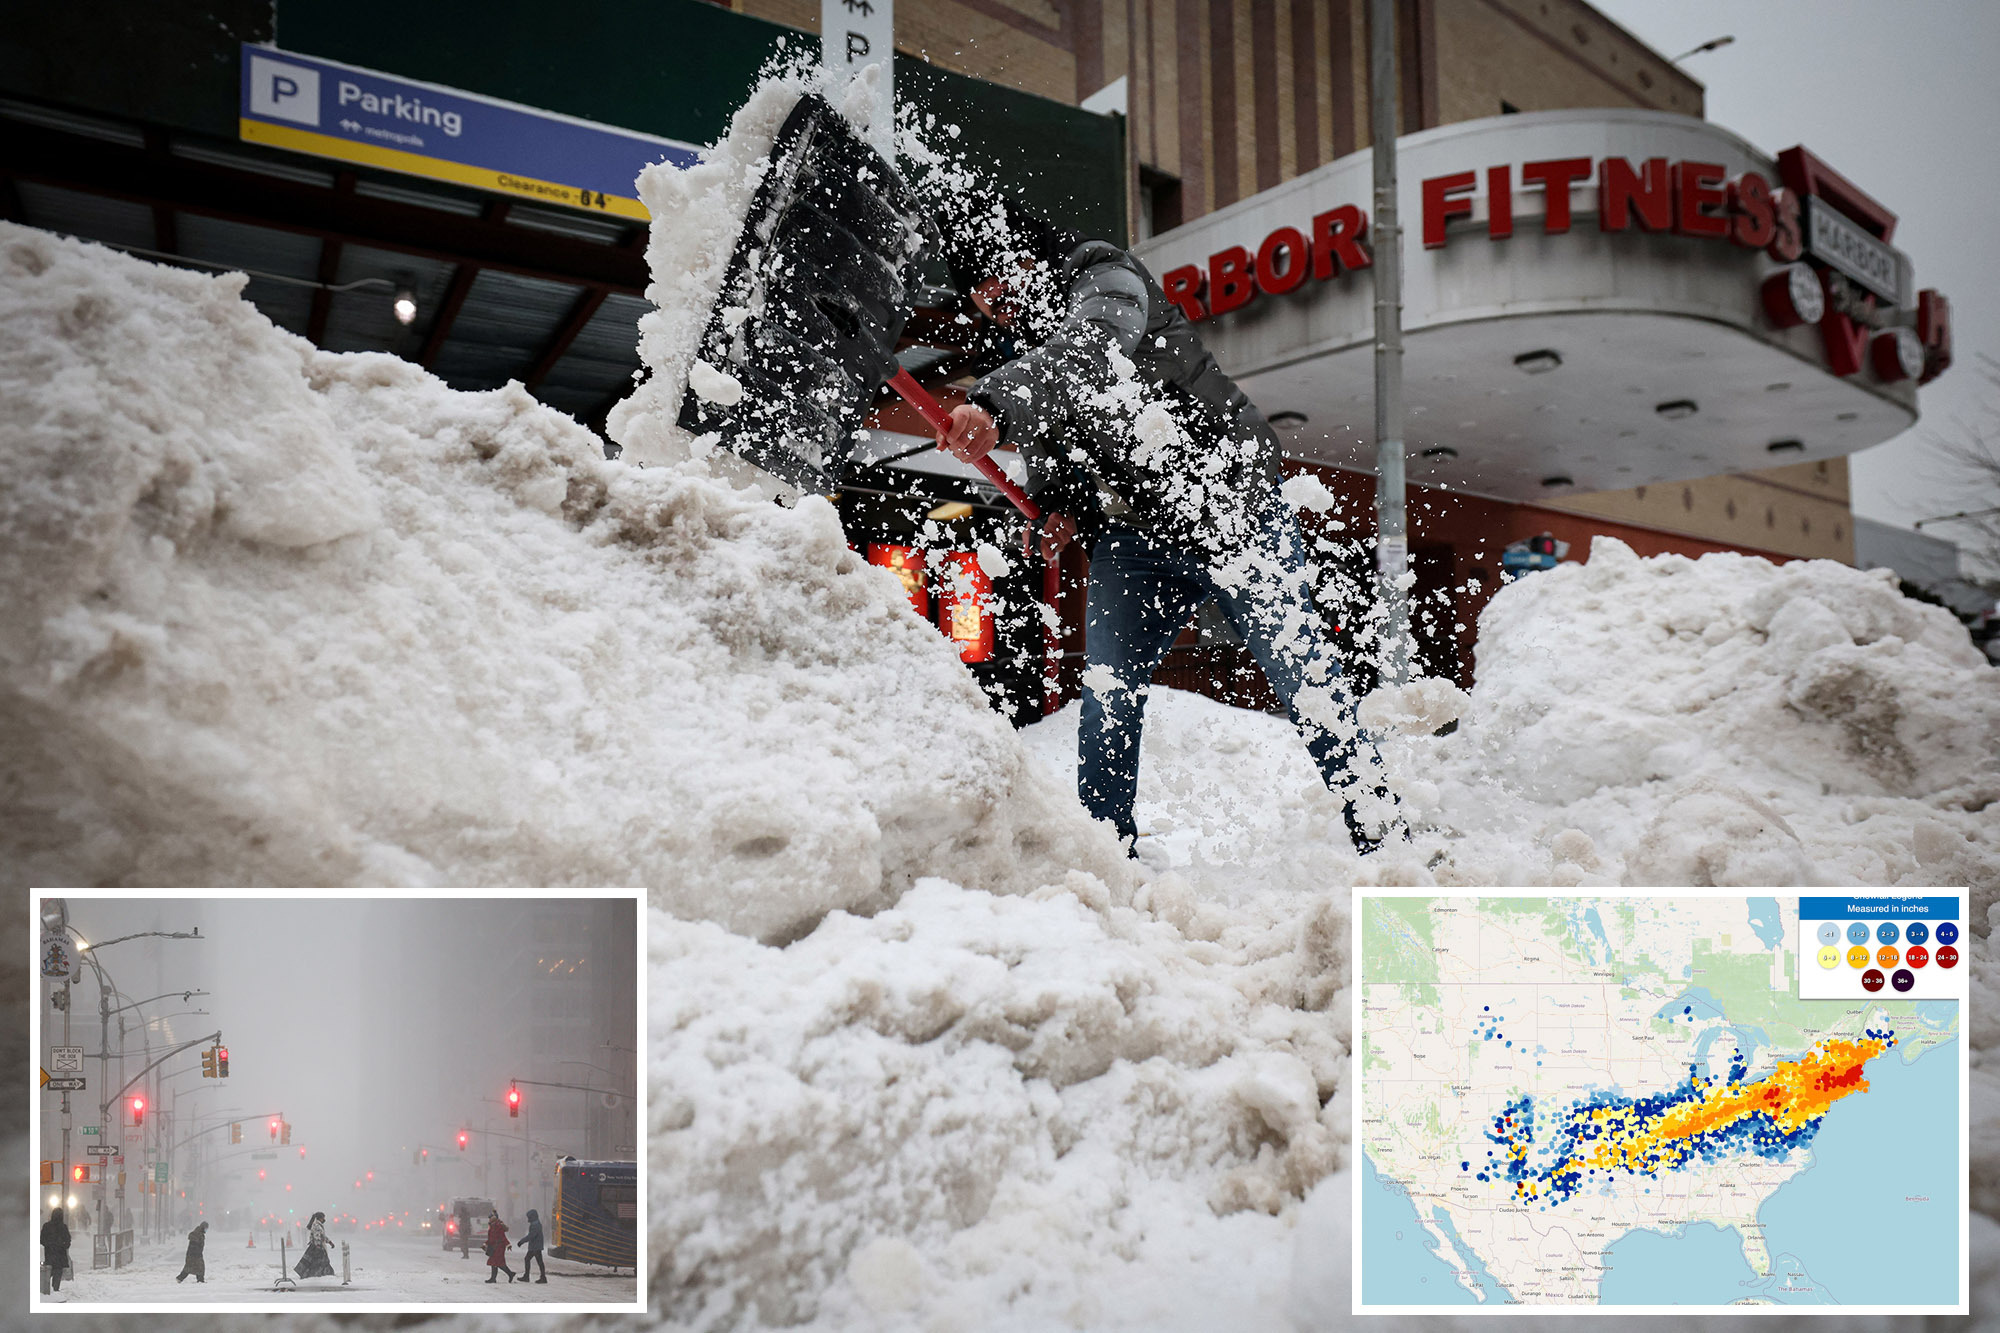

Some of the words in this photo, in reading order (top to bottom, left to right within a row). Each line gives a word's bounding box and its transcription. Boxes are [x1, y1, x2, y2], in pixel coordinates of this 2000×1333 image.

[273, 75, 298, 103] P
[338, 81, 462, 137] Parking
[364, 126, 425, 147] metropolis
[497, 174, 570, 200] Clearance
[1422, 156, 1804, 265] FITNESS
[42, 936, 70, 945] BAHAMAS
